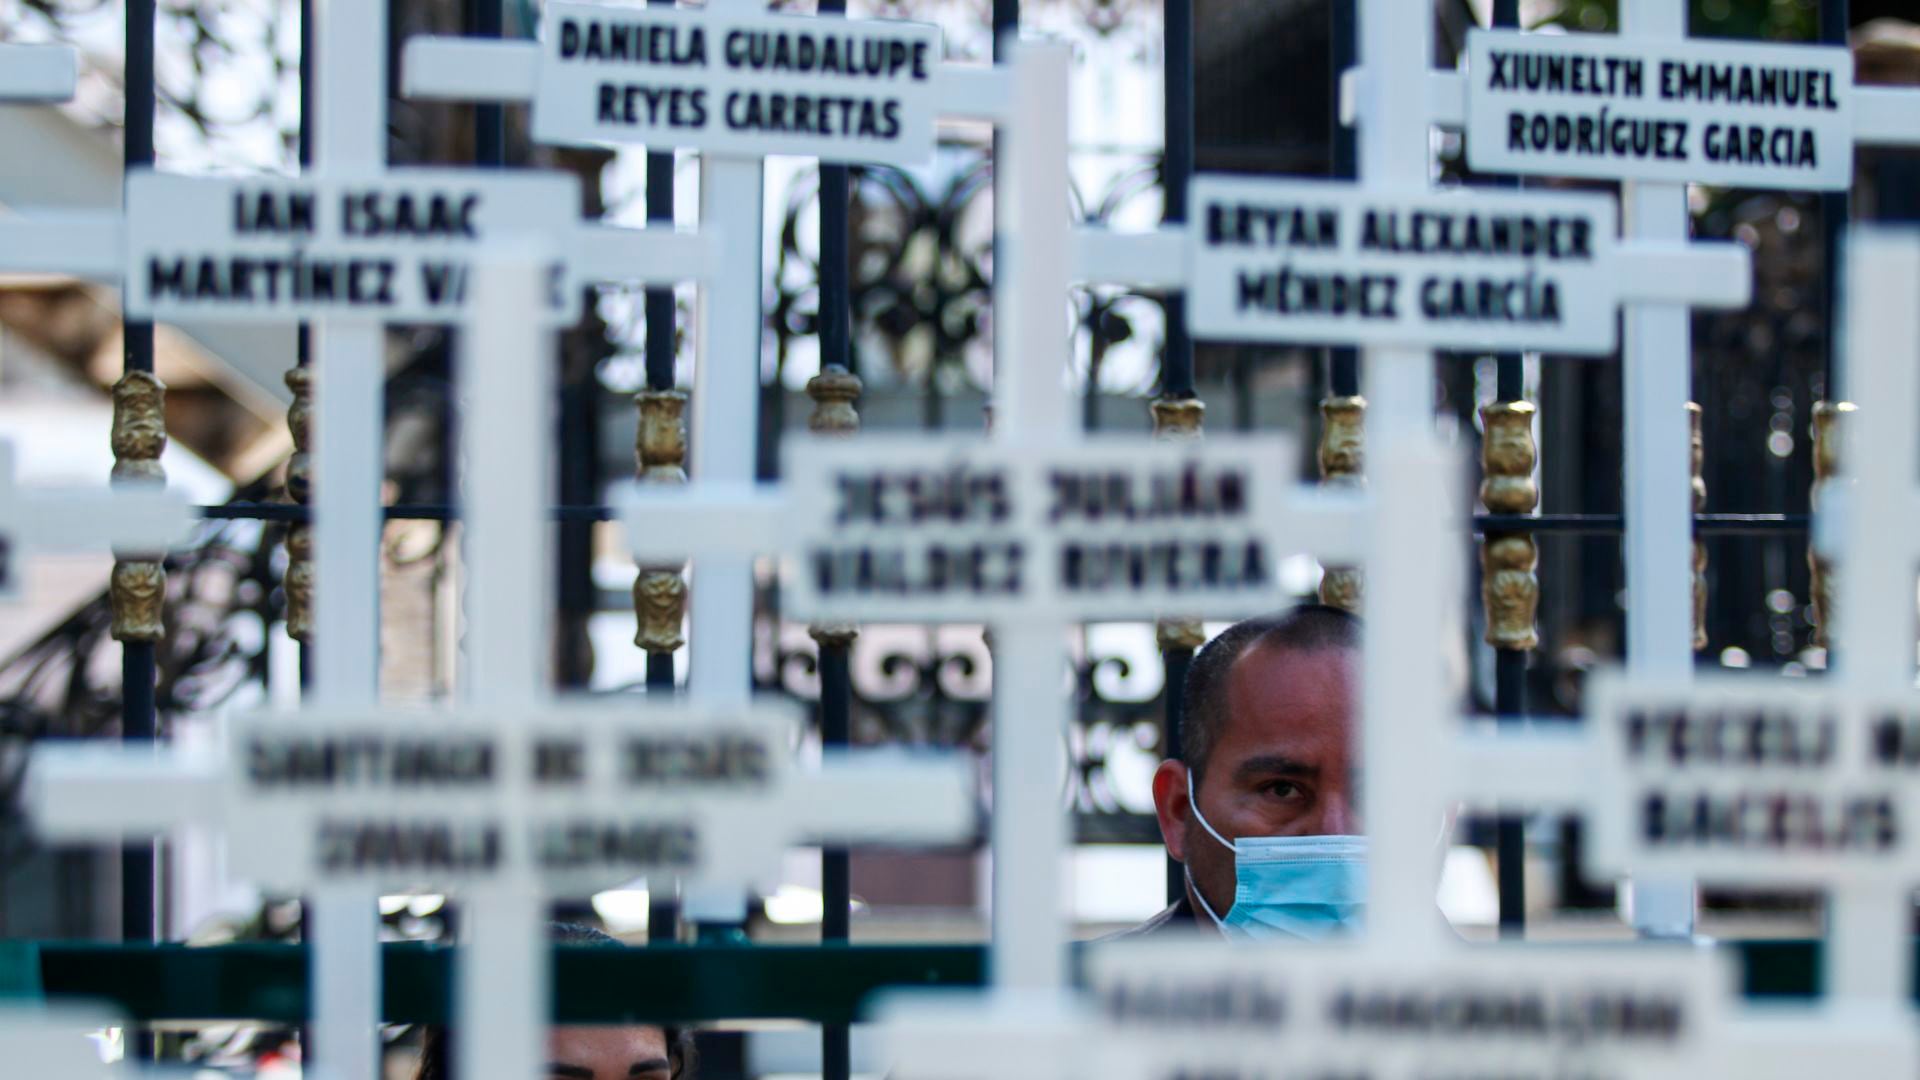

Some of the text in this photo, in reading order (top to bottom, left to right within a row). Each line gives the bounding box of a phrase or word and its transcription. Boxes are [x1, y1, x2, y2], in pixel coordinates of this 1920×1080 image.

[559, 19, 929, 80] DANIELA GUADALUPE
[1489, 52, 1838, 110] XIUNELTH EMMANUEL
[596, 83, 901, 140] REYES CARRETAS
[1508, 106, 1818, 168] RODRÍGUEZ GARCIA
[234, 191, 479, 239] IAN ISAAC
[1206, 203, 1592, 260] BRYAN ALEXANDER
[147, 245, 396, 305] MARTÍNEZ
[1236, 260, 1400, 320] MÉNDEZ
[1061, 540, 1267, 592] RIVERA
